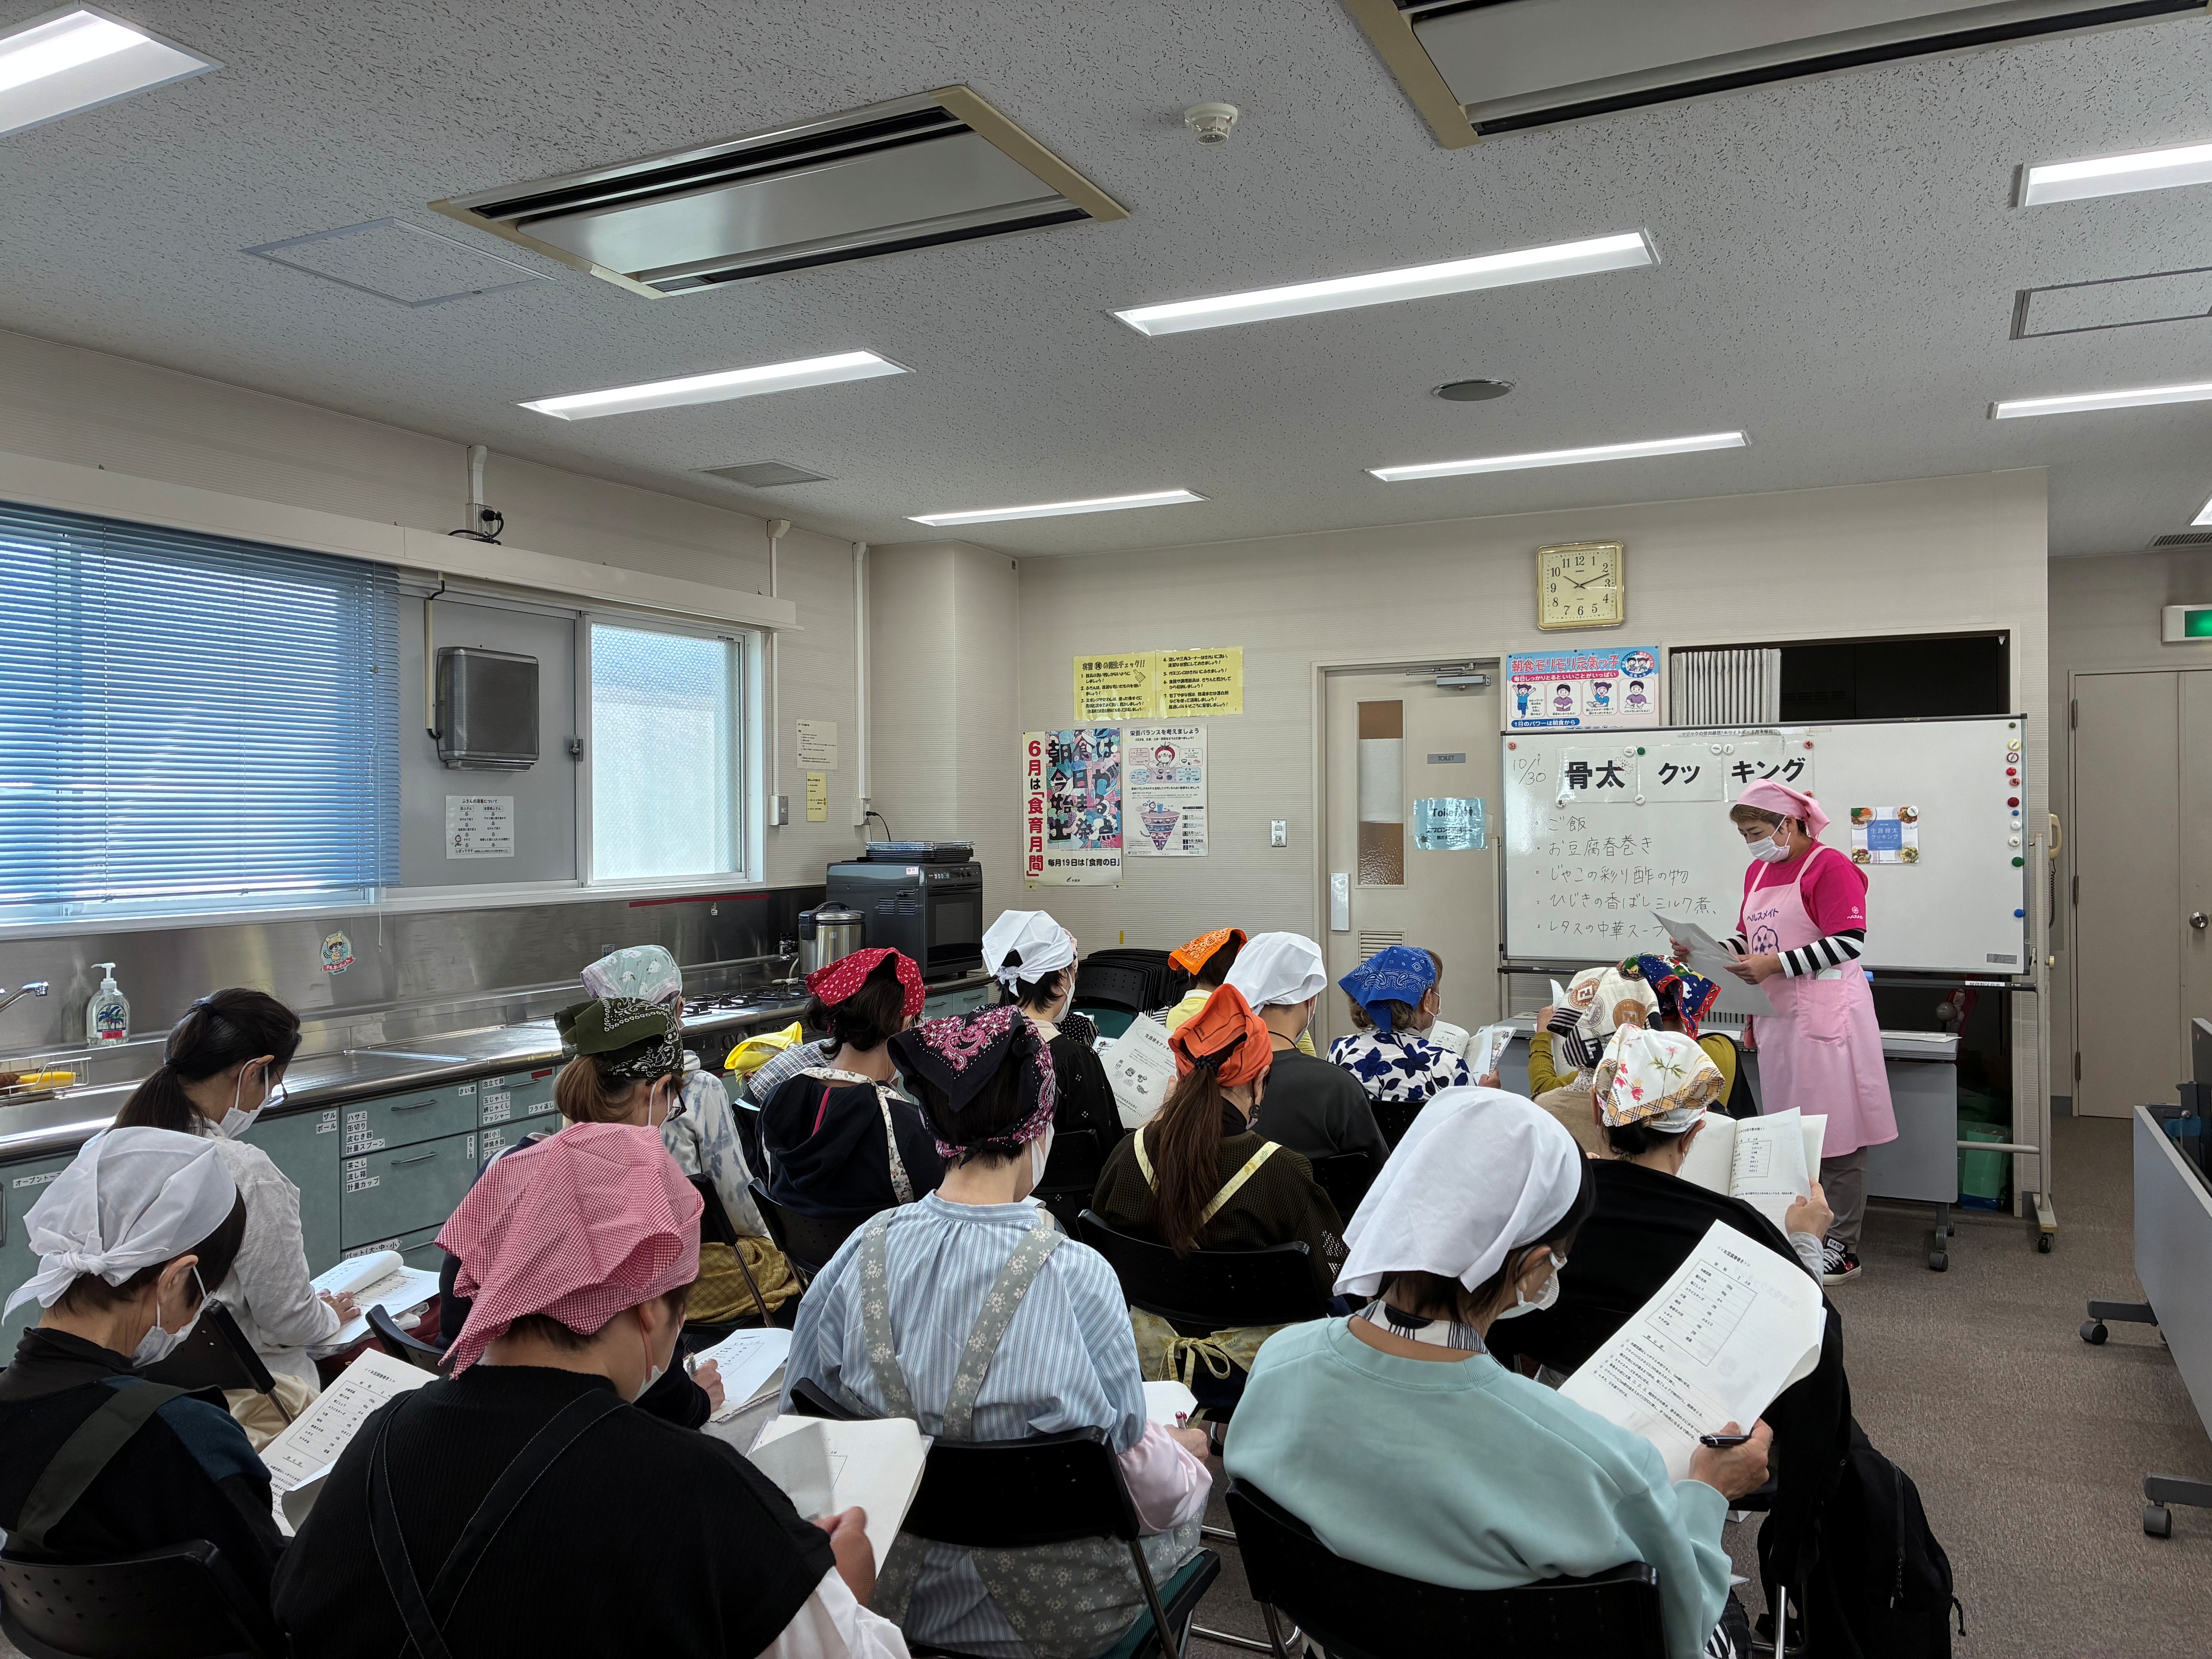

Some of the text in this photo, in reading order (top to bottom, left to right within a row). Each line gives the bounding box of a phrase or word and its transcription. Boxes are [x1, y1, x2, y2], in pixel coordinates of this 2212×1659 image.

[1562, 558, 1570, 567] 11
[1575, 556, 1585, 565] 12
[1591, 556, 1595, 565] 1
[1551, 567, 1560, 577] 10
[1602, 563, 1608, 573] 2
[1551, 583, 1556, 592] 9
[1605, 579, 1610, 587] 3
[1553, 597, 1558, 606] 8
[1603, 594, 1609, 603] 4
[1564, 605, 1570, 615] 7
[1578, 606, 1583, 615] 6
[1592, 603, 1597, 613] 5
[1511, 654, 1620, 673] 朝食モリモリ元気っ子
[1130, 728, 1199, 736] 栄養バランスを考えましょう
[1565, 758, 1806, 790] 骨太 クッ キング
[1026, 740, 1044, 877] 6月は「食育月間」
[1549, 816, 1587, 831] ご飯
[1549, 834, 1652, 857] お豆腐春巻き
[1048, 858, 1120, 867] 毎月19日は「食育の日」
[1552, 864, 1688, 886] じゃこの彩り酢の物
[1747, 908, 1779, 922] ヘルスメイト
[483, 1078, 504, 1088] 泡立て器
[460, 1087, 475, 1095] さい箸
[484, 1093, 509, 1103] 玉じゃくし
[484, 1103, 509, 1113] 網じゃくし
[529, 1103, 553, 1113] フライ返し
[348, 1113, 366, 1121] ハサミ
[484, 1113, 510, 1122] マッシャー
[347, 1123, 365, 1132] 缶切り
[347, 1132, 372, 1142] 皮むき器
[484, 1130, 500, 1139] 鍋(小)
[347, 1141, 384, 1153] 計量スプーン
[484, 1139, 504, 1148] 卵焼き器
[347, 1160, 366, 1169] 茶こし
[347, 1171, 366, 1181] 流し箱
[347, 1178, 379, 1192] 計量カップ
